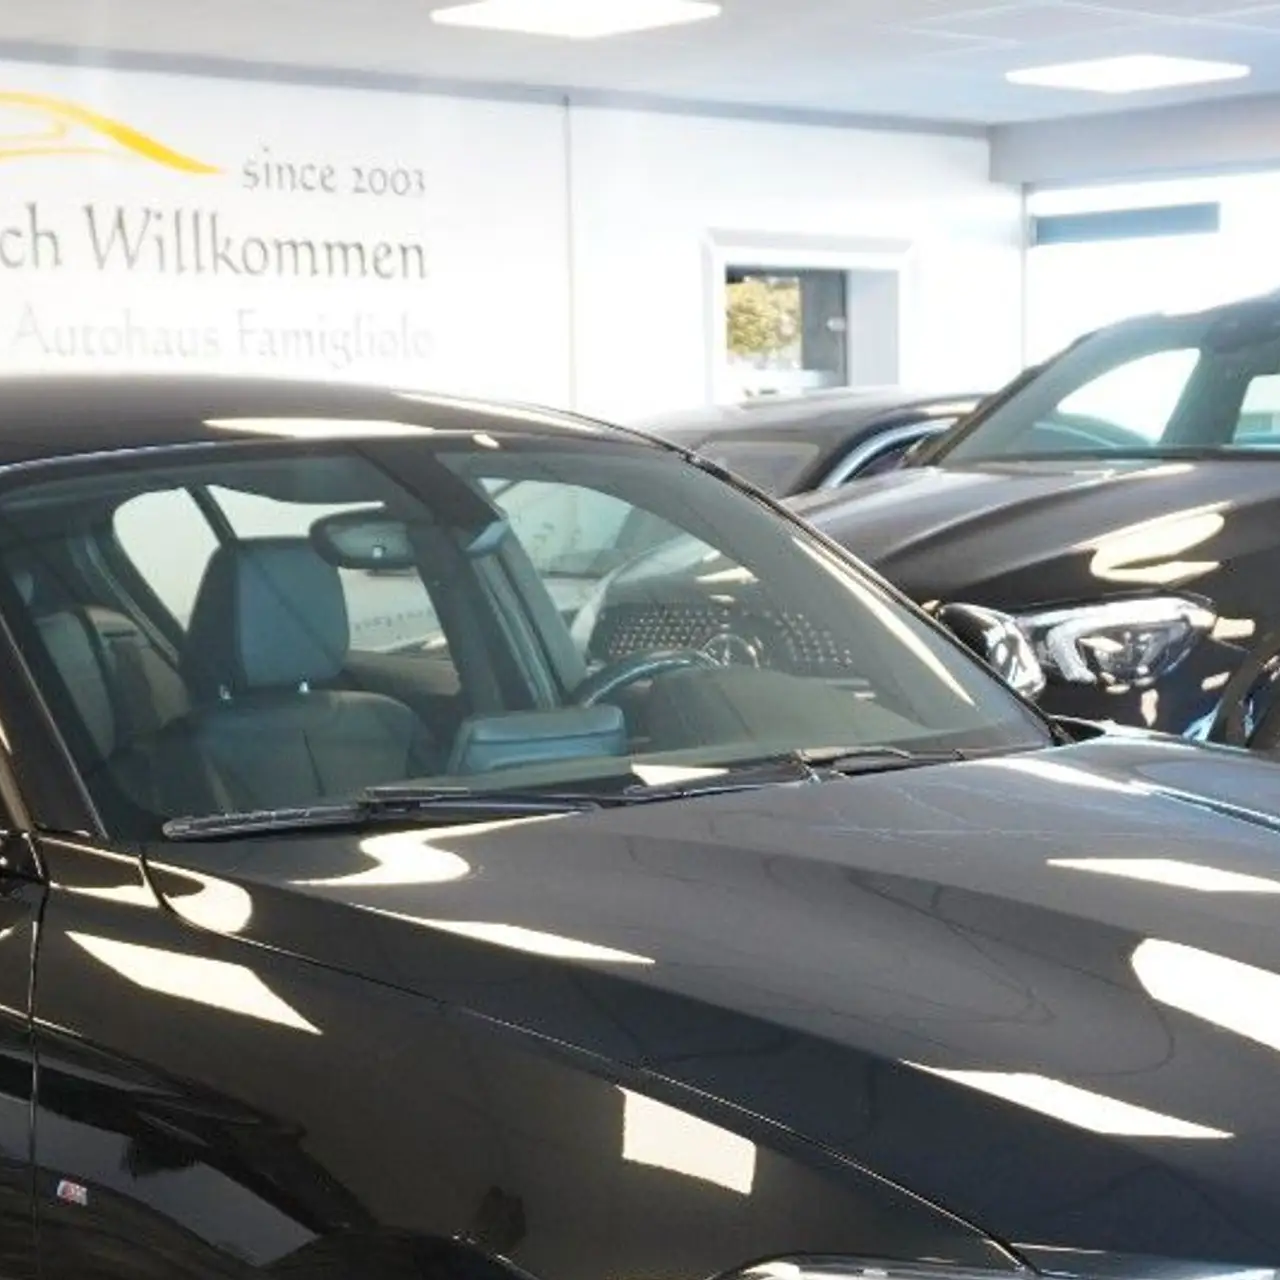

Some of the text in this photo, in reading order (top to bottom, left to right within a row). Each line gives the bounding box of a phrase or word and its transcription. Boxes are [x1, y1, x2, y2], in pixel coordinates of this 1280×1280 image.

[241, 145, 426, 196] since 2003
[81, 203, 428, 281] Willkommen
[13, 299, 221, 359] Autohaus
[236, 306, 436, 371] Famigliolo
